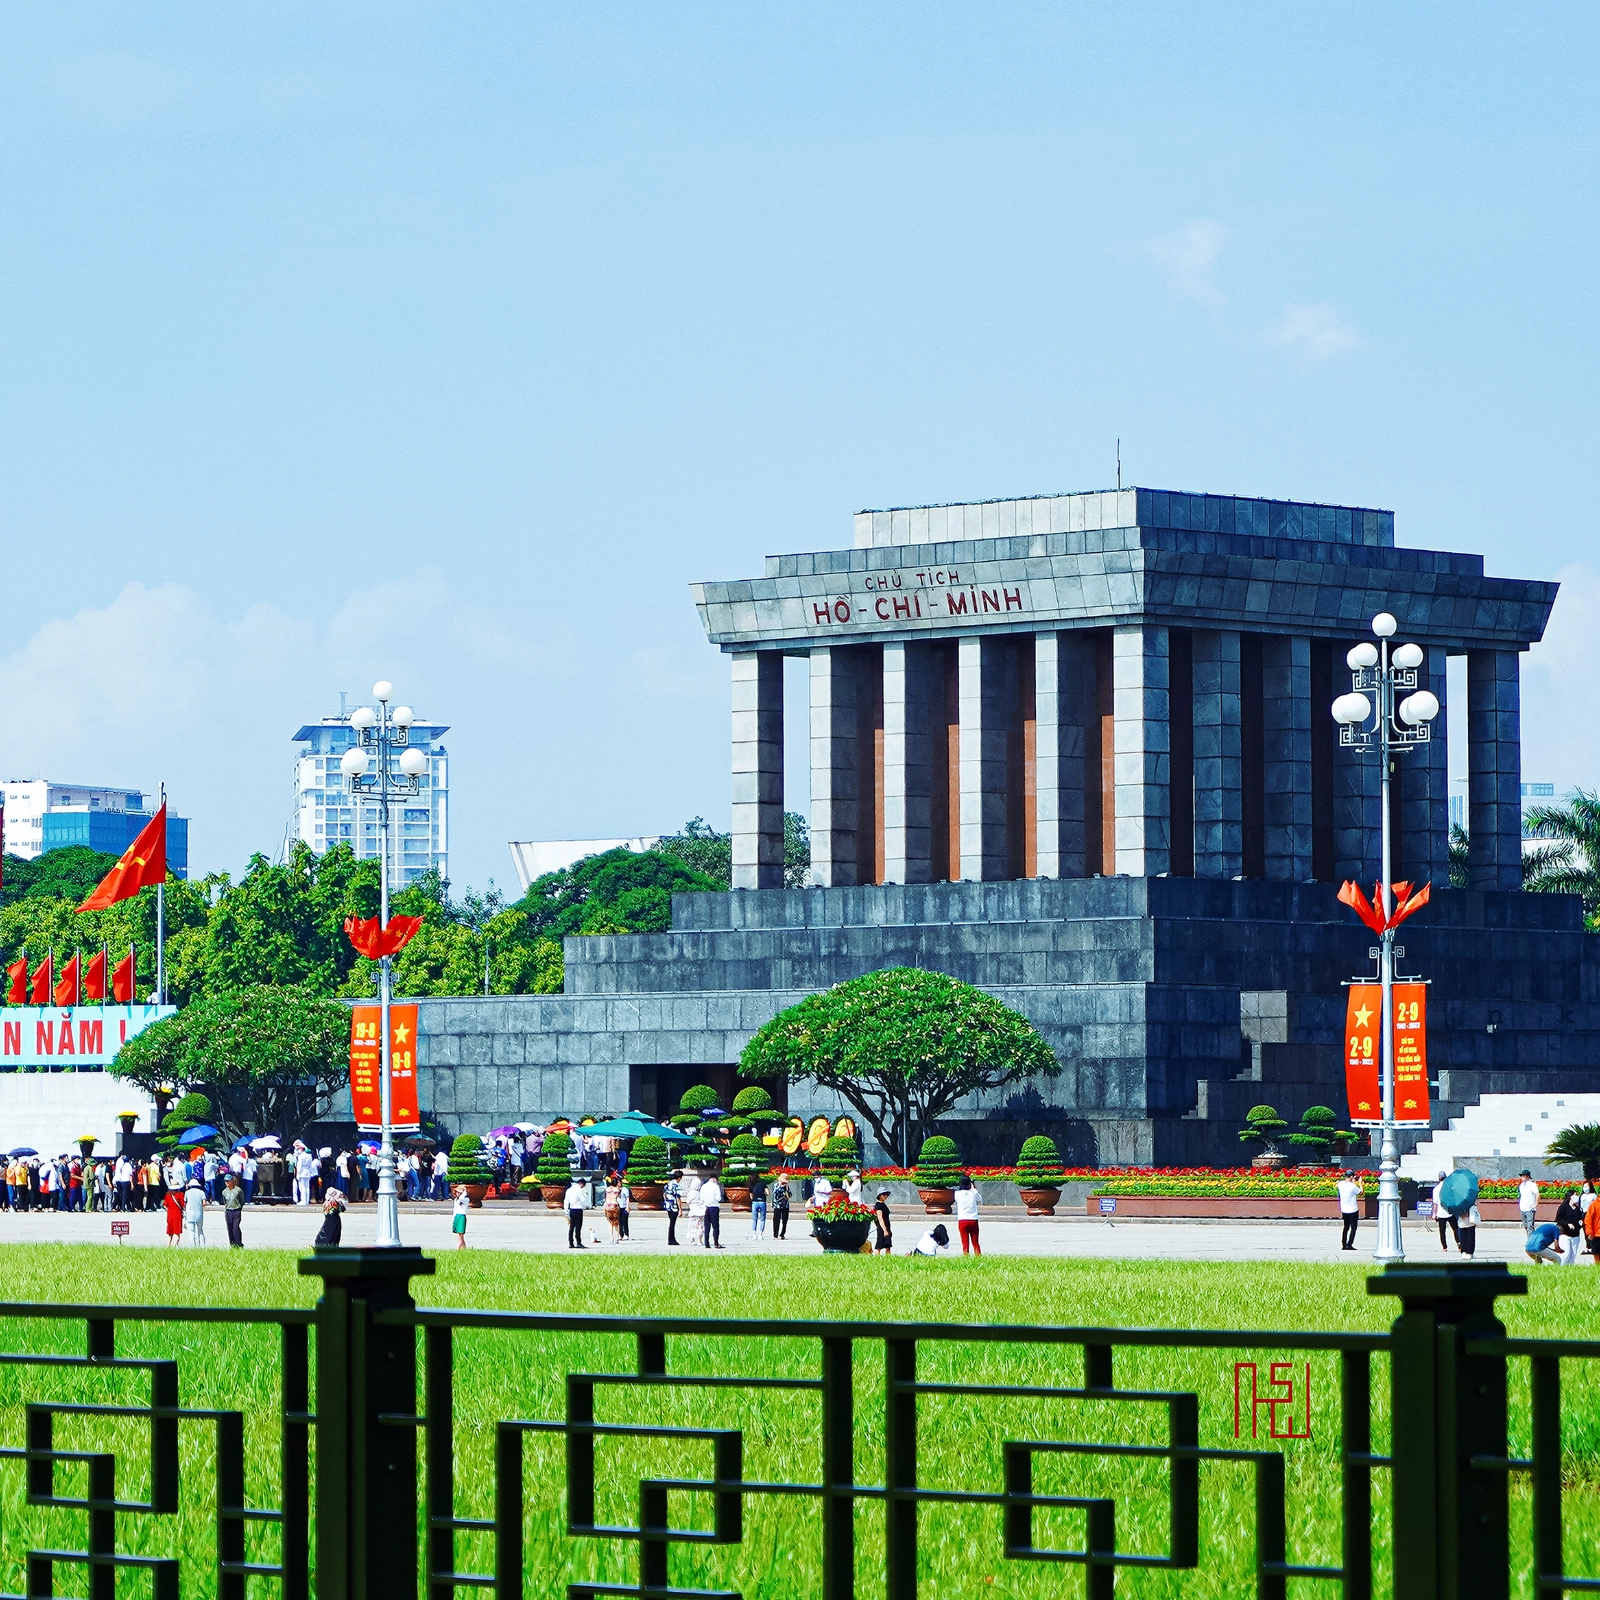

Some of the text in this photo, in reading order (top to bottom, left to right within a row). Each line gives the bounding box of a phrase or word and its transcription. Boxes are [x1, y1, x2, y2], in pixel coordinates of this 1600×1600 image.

[1399, 1002, 1418, 1021] 2-9
[36, 1012, 103, 1055] NĂM
[1350, 1037, 1373, 1057] 2-9
